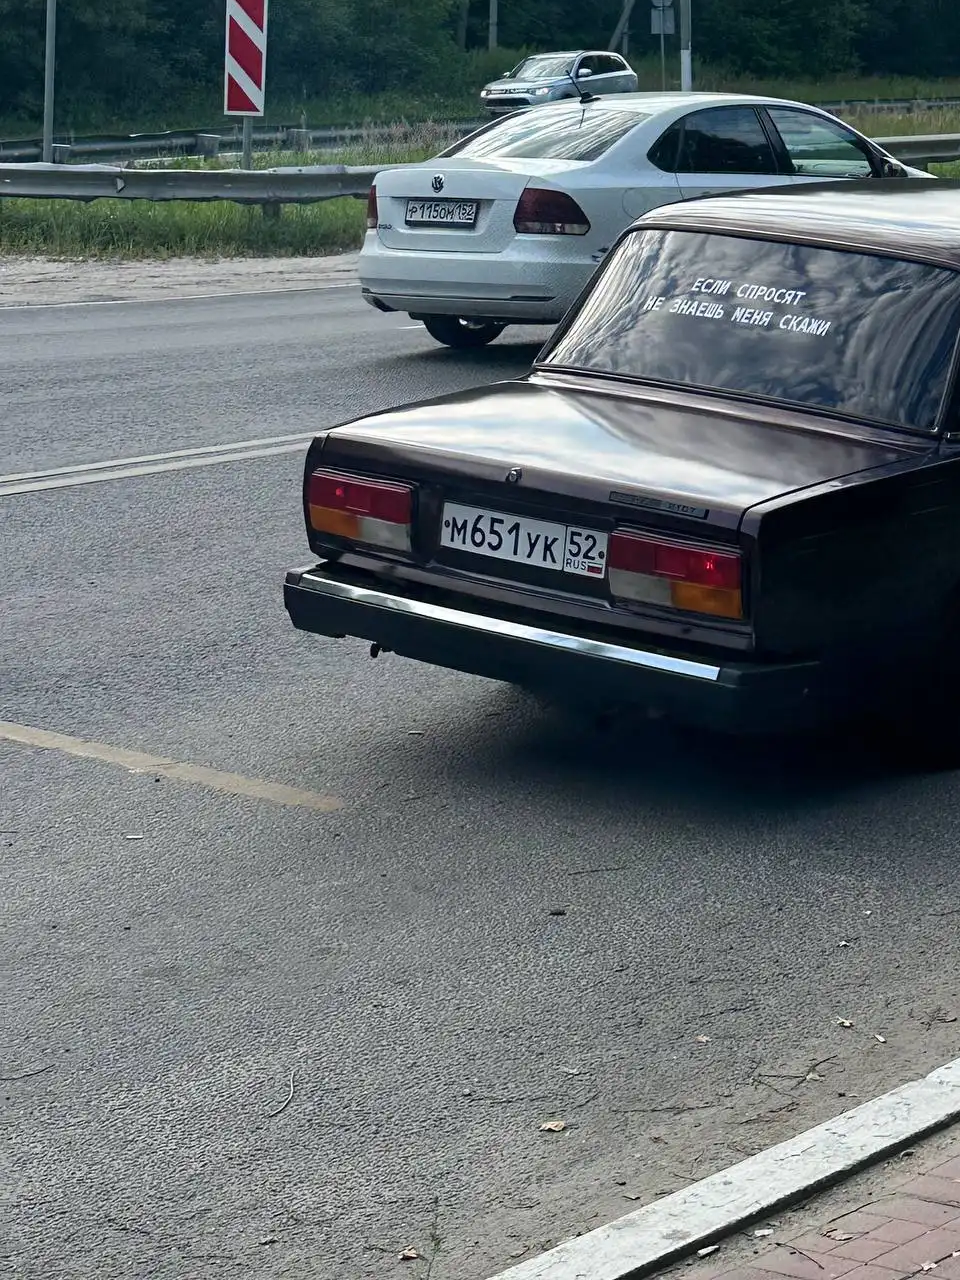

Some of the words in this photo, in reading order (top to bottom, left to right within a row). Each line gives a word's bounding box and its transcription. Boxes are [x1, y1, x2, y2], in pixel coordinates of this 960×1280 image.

[691, 278, 731, 296] ЕСЛИ
[736, 284, 807, 306] СПРОСЯТ
[643, 296, 666, 312] НЕ
[669, 298, 725, 320] ЗНАЕШЬ
[731, 307, 774, 327] МЕНЯ
[779, 314, 832, 337] СКАЖИ
[450, 514, 560, 564] М651УК
[568, 531, 598, 561] 52
[565, 558, 588, 571] RUS
